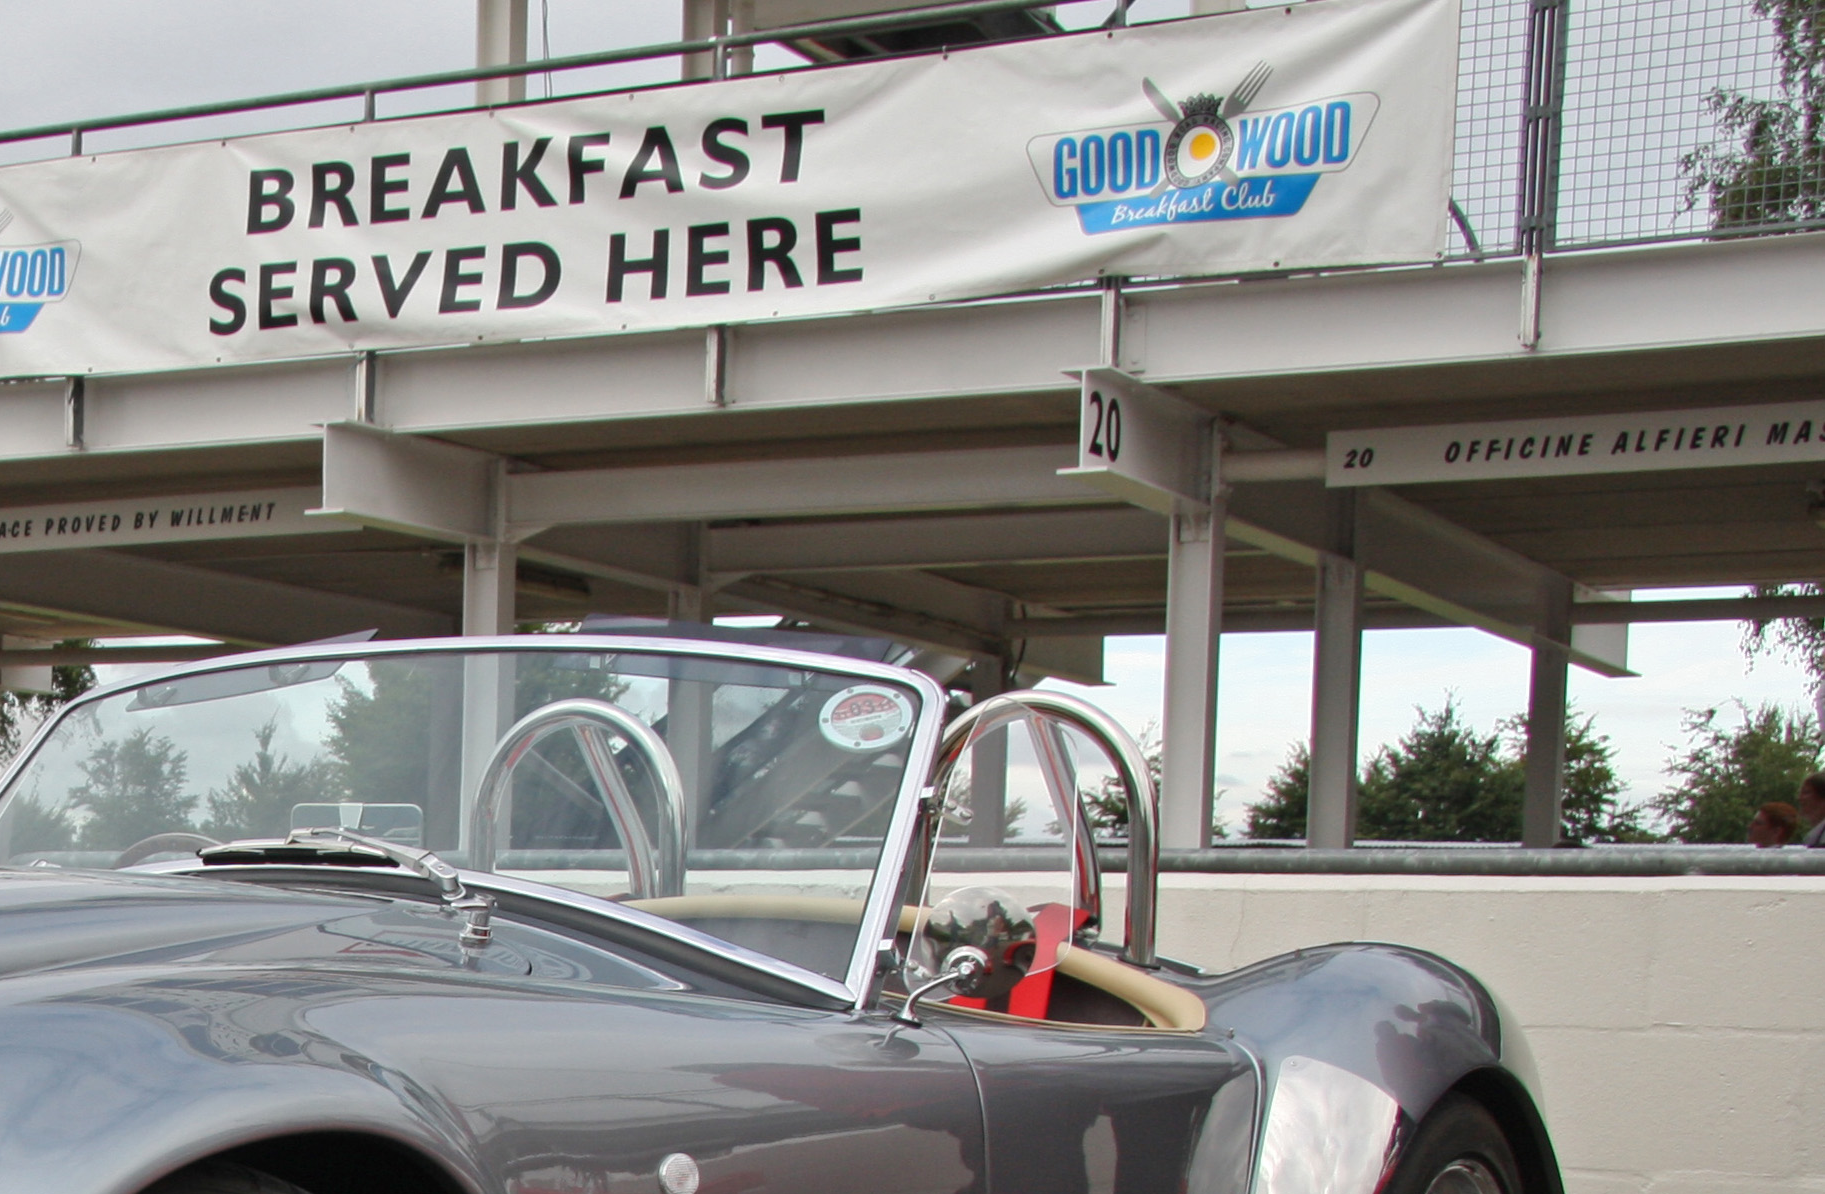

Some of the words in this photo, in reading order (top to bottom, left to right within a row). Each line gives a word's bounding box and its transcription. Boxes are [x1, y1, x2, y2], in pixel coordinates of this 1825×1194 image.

[245, 109, 825, 236] BREAKFAST
[1053, 129, 1161, 200] GOOD
[1236, 101, 1352, 172] WOOD
[1111, 187, 1214, 225] Breakfast
[1221, 181, 1276, 210] Club
[208, 241, 562, 337] SERVED
[605, 207, 864, 304] HERE
[1087, 390, 1122, 463] 20
[1343, 448, 1374, 470] 20
[1444, 432, 1593, 464] OFFICINE
[1610, 423, 1747, 455] ALFIERI
[44, 514, 122, 536] PROVED
[133, 510, 160, 530] BY
[170, 502, 277, 528] WILLMENT
